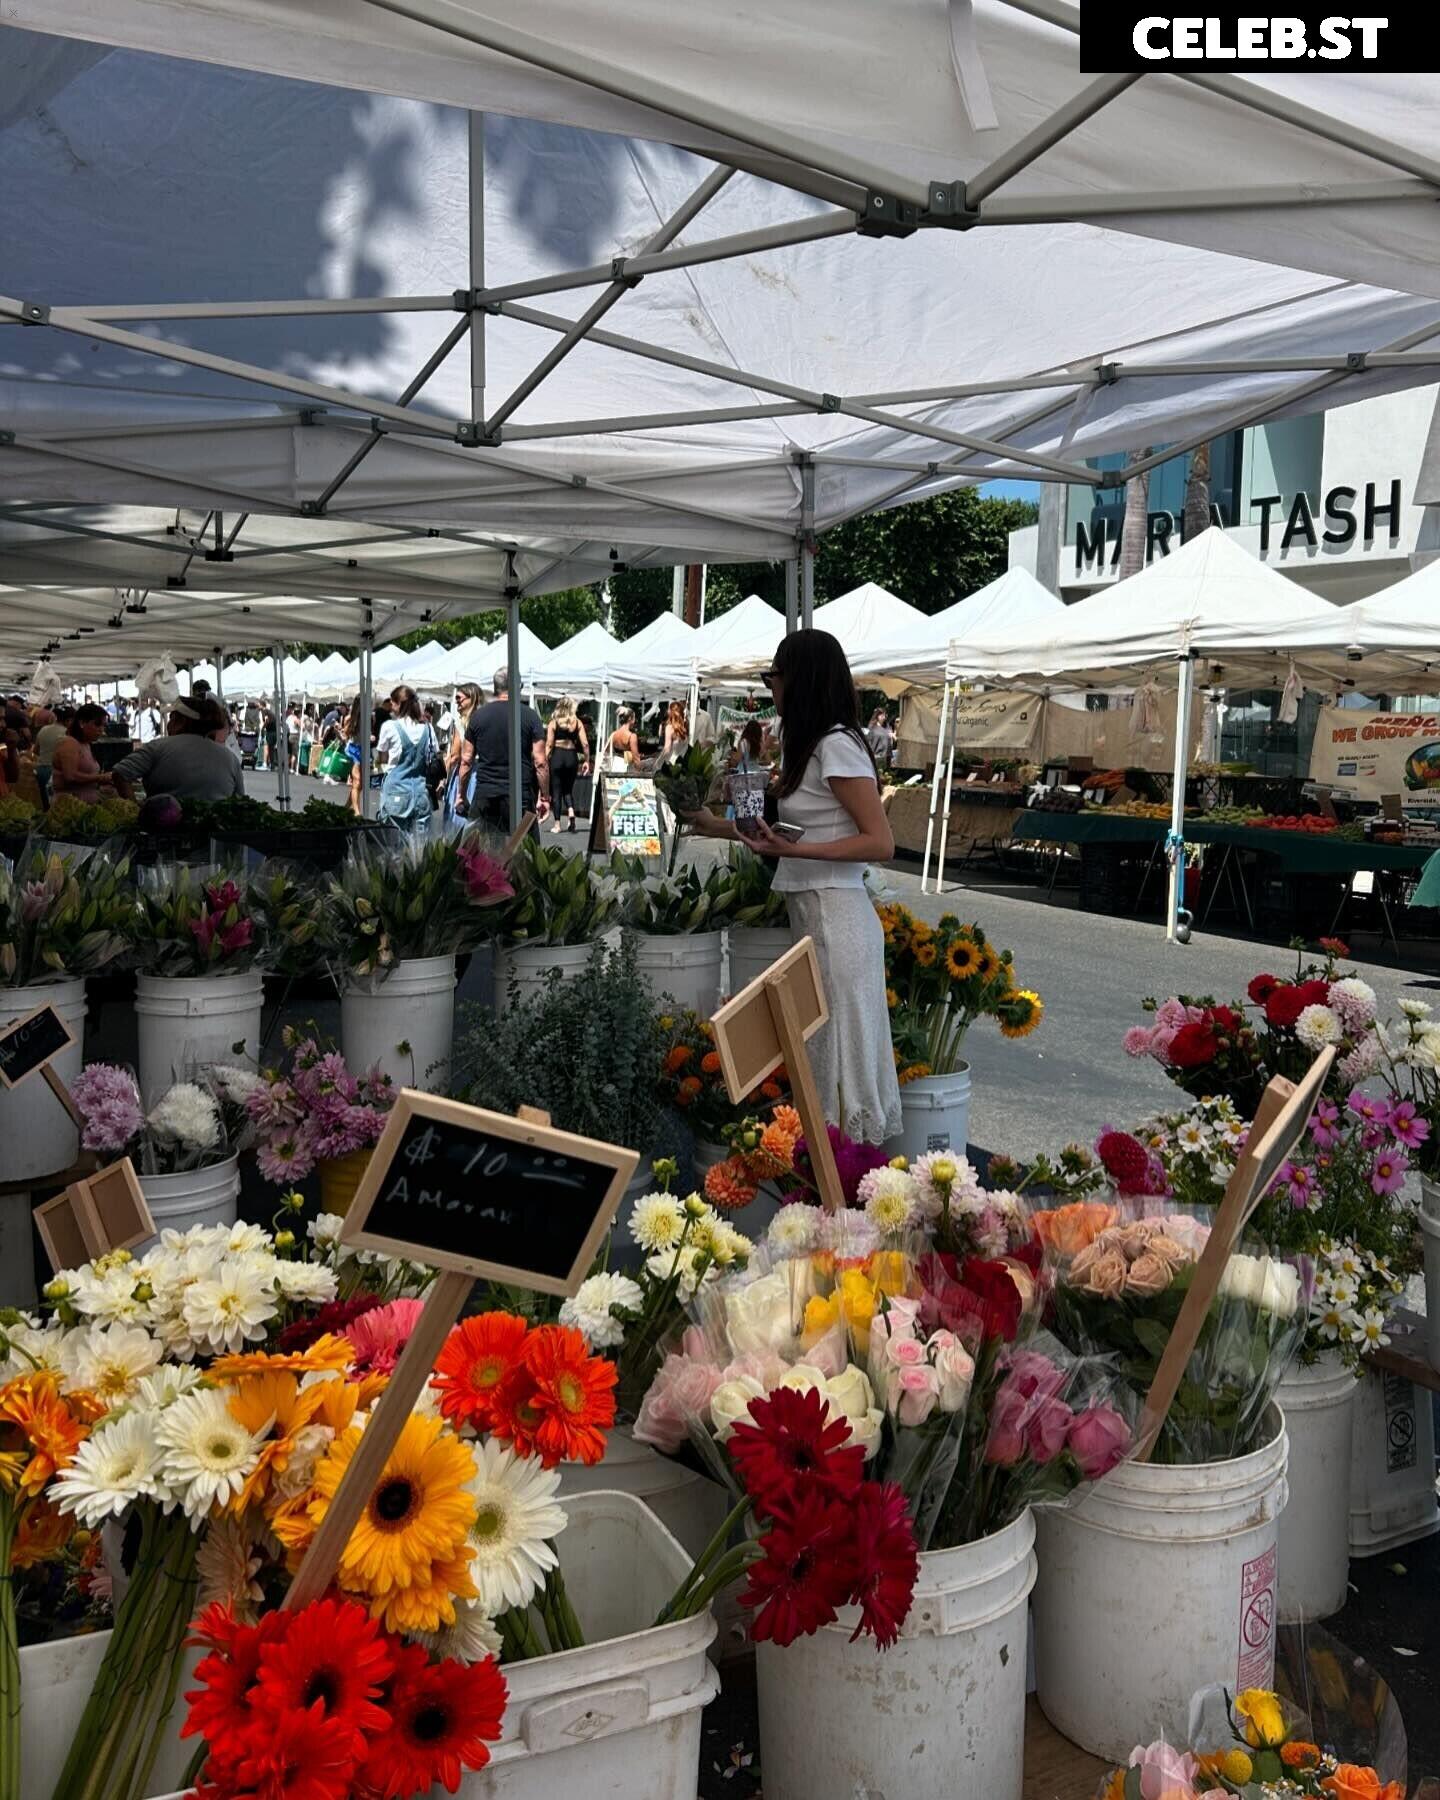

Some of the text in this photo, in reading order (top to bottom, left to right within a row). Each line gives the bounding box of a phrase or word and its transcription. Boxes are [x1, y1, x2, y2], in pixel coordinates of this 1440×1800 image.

[1250, 478, 1402, 551] TASH
[1332, 727, 1358, 743] WE
[1361, 726, 1418, 741] GROW
[613, 821, 655, 836] FREE
